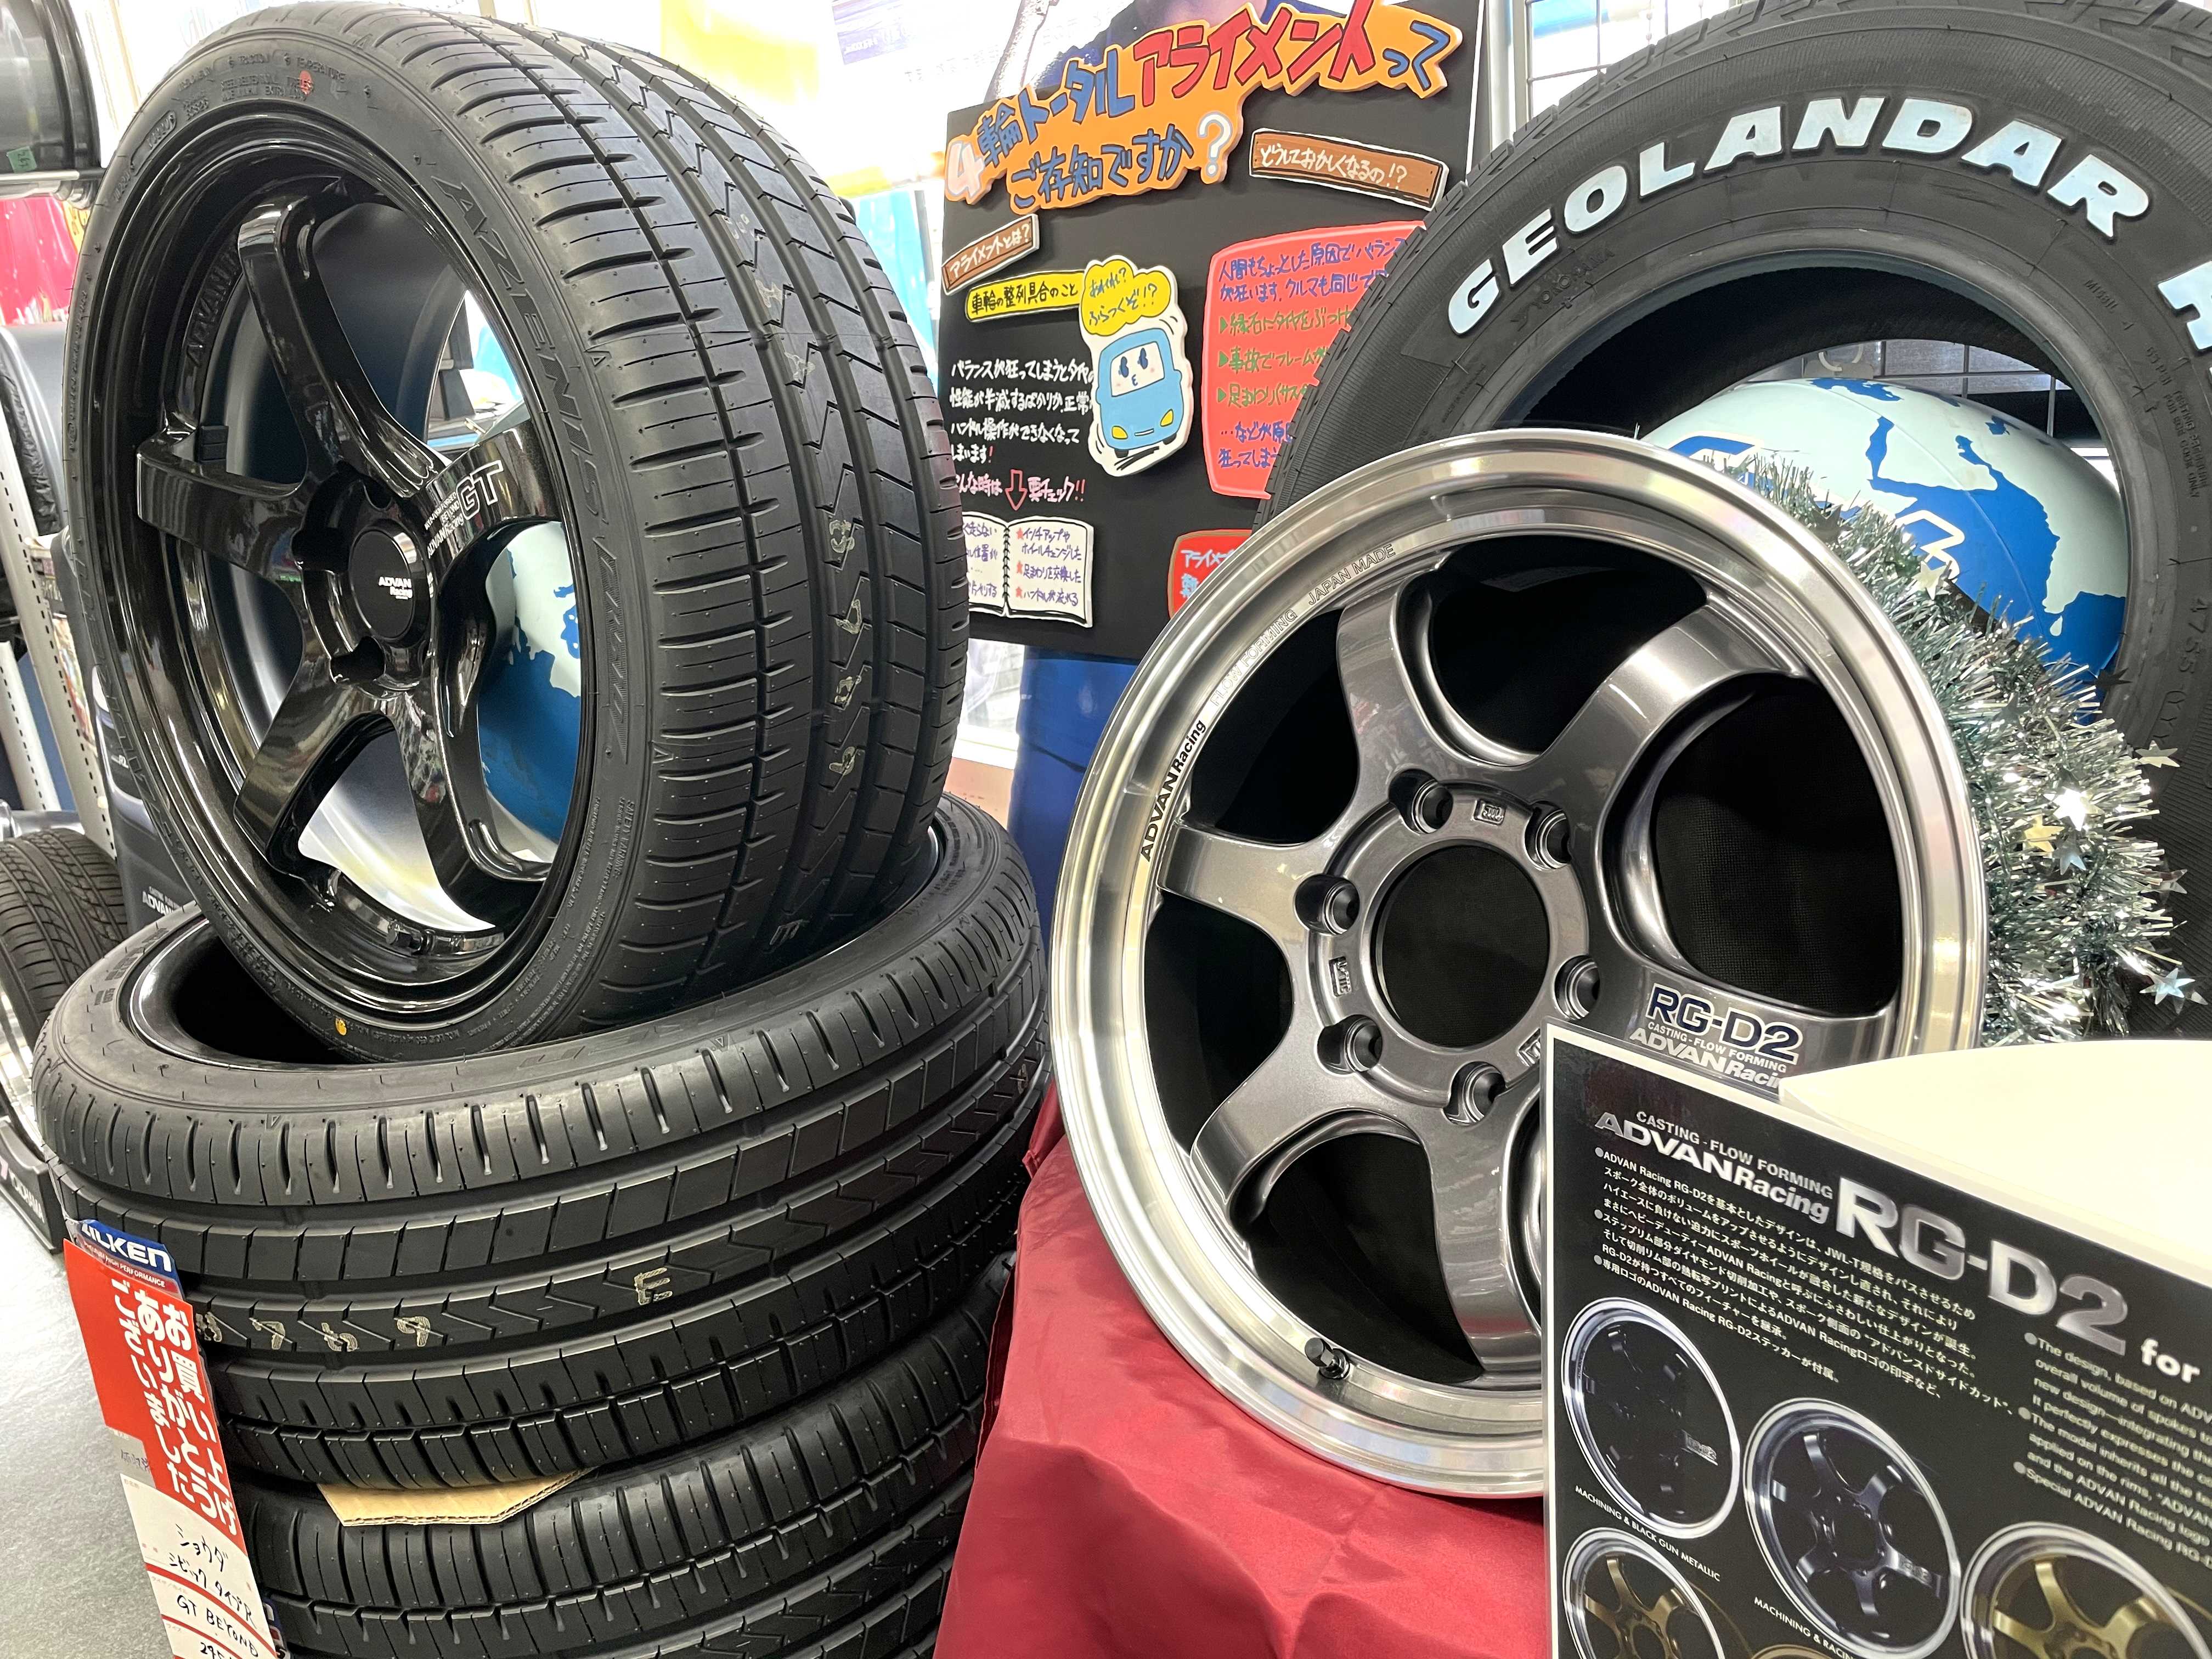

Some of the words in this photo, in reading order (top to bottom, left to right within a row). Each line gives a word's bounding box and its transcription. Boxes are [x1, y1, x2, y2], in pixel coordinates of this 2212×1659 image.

[1011, 111, 1232, 207] ご存知ですか?
[1261, 143, 1408, 190] どうしておかしくなるの!?
[1448, 96, 2151, 336] GEOLANDAR
[949, 223, 1030, 278] アライメントとは?
[971, 280, 1078, 316] 車輪の整列具合のこと
[431, 176, 600, 516] AZENIS
[455, 460, 504, 521] GT
[1027, 475, 1086, 503] 要チェック!!
[379, 576, 412, 588] ADVAN
[1022, 543, 1081, 561] ホイールチェンジした
[1308, 568, 1351, 606] JAPAN
[1352, 543, 1397, 575] MADE
[1210, 664, 1240, 708] FLOW
[1240, 609, 1299, 669] FORMING
[1646, 983, 1803, 1065] RG-D2
[1647, 1021, 1688, 1042] CASTING
[1694, 1037, 1726, 1054] FLOW
[1728, 1048, 1787, 1074] FORMING
[1602, 1150, 1637, 1172] ADVAN
[1639, 1165, 1672, 1189] Racing
[1636, 1111, 1700, 1146] CASTING
[1710, 1139, 1753, 1165] FLOW
[1757, 1159, 1833, 1200] FORMING
[120, 1263, 166, 1288] PERFORMANCE
[1836, 1176, 2128, 1356] RG-D2
[2140, 1338, 2200, 1384] for
[1682, 1296, 1715, 1321] Racing
[110, 1278, 196, 1504] ございました
[134, 1288, 218, 1519] ありがとう
[2038, 1338, 2062, 1357] The
[2115, 1372, 2157, 1400] based
[2158, 1394, 2177, 1409] on
[2180, 1402, 2212, 1425] ADV
[162, 1302, 237, 1536] お買い上げ
[2032, 1412, 2056, 1432] The
[1575, 1485, 1622, 1521] MACHINING
[1623, 1515, 1631, 1525] &
[1631, 1520, 1657, 1543] BLACK
[1658, 1538, 1679, 1556] GUN
[1680, 1552, 1721, 1583] METALLIC
[2073, 1492, 2124, 1524] ADVAN
[2125, 1516, 2173, 1551] Racing
[2076, 1475, 2126, 1506] ADVAN
[2129, 1498, 2177, 1533] Racing
[177, 1594, 198, 1617] GT
[206, 1607, 259, 1658] BEYOND
[1754, 1597, 1811, 1638] MACHINING
[1812, 1633, 1821, 1644] &
